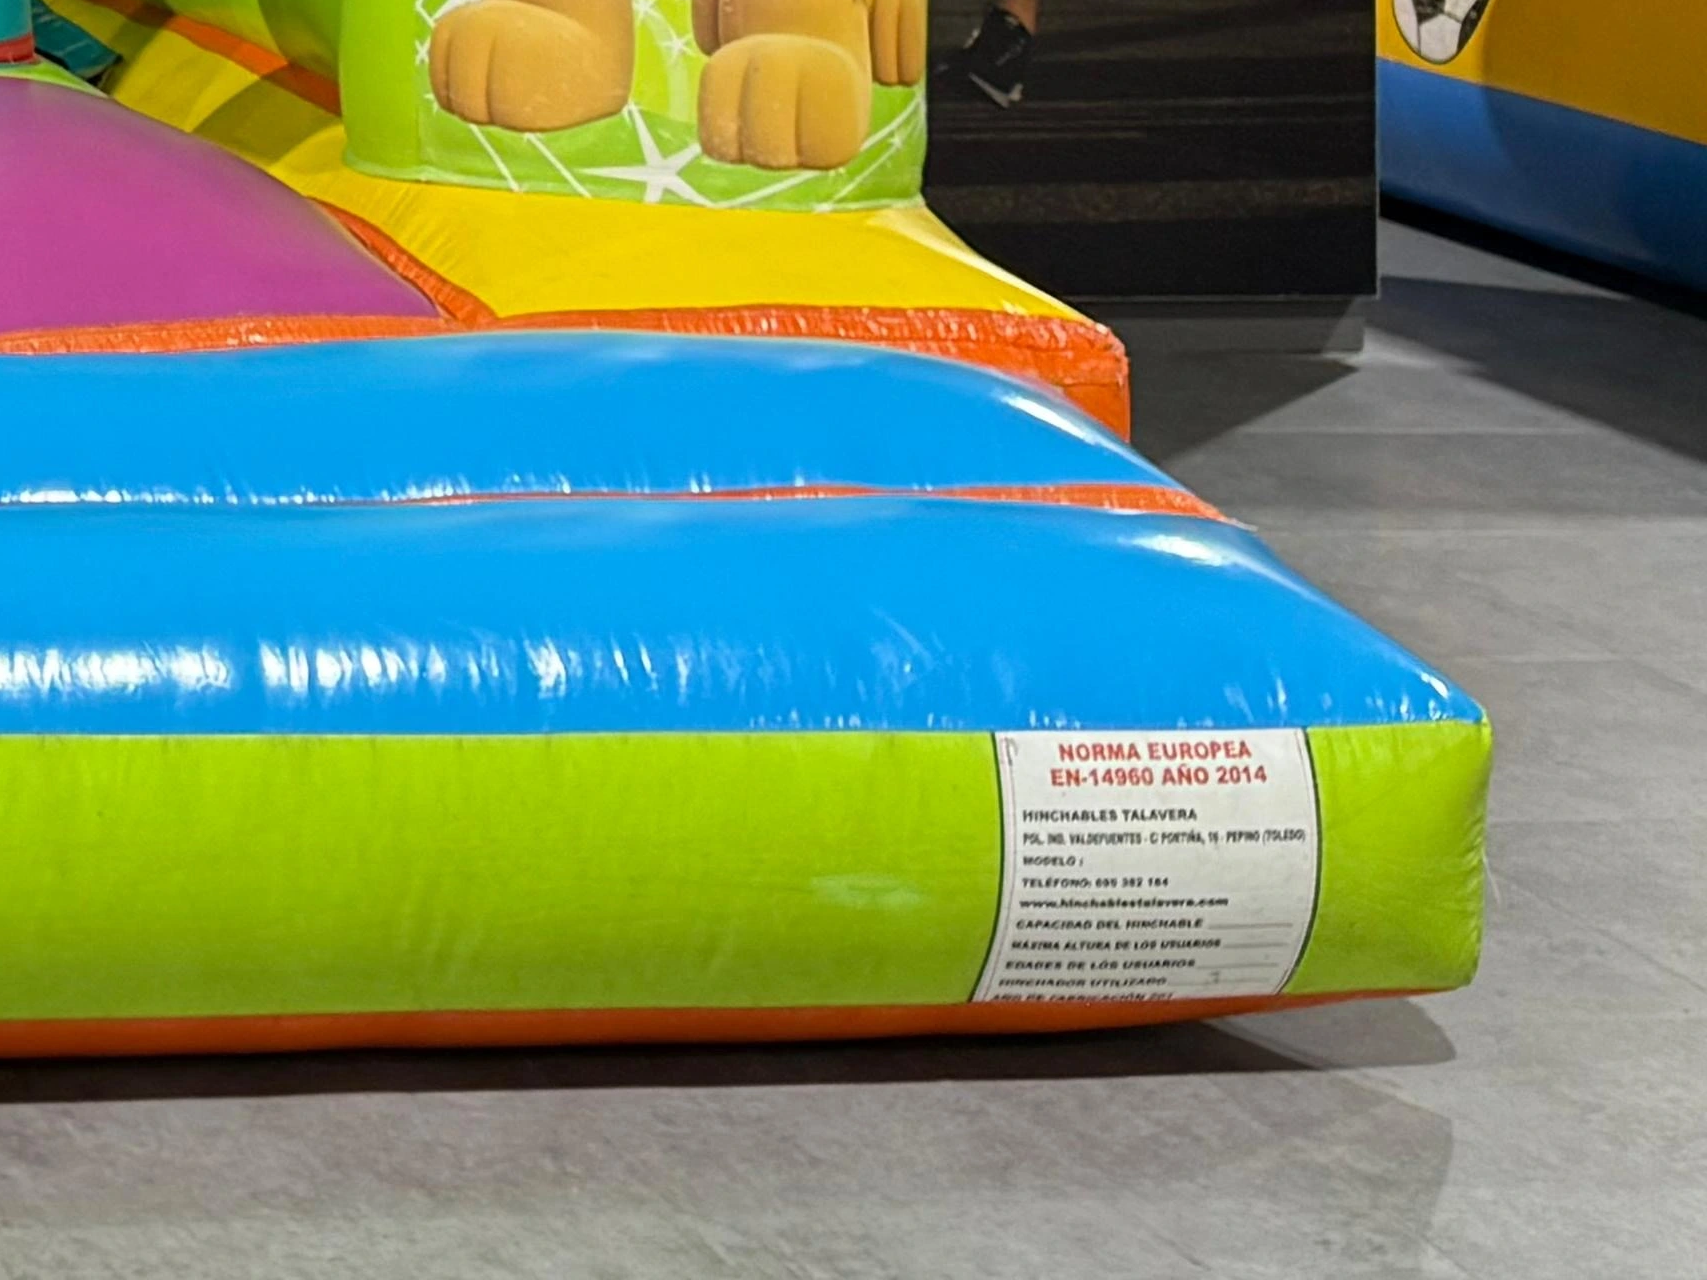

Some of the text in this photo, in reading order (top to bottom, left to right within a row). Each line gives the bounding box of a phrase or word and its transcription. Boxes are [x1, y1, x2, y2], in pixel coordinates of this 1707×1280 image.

[1059, 740, 1252, 762] NORMA EUROPEA
[1050, 762, 1268, 787] EN-14960 AÑO 2014
[1022, 807, 1198, 822] HINCHABLES TALAVERA
